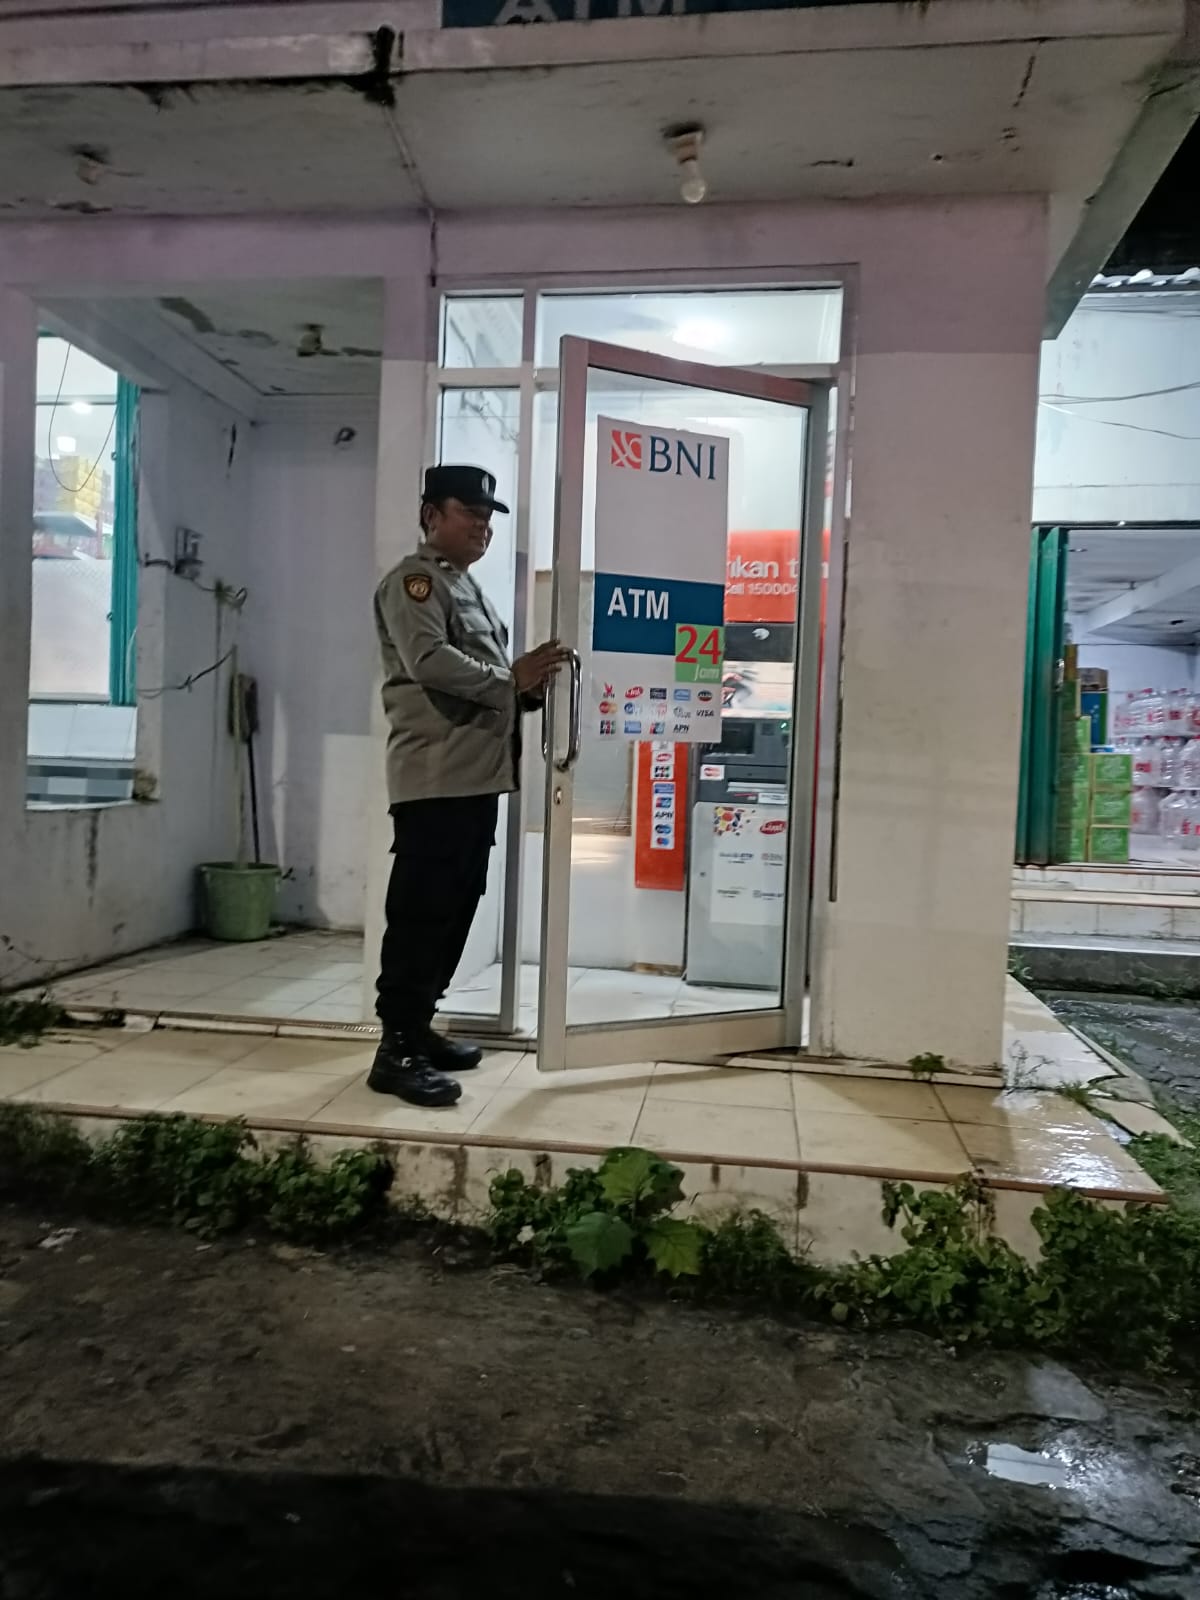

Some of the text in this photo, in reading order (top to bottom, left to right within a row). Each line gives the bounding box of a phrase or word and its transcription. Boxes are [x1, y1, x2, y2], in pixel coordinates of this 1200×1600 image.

[648, 434, 717, 481] BNI
[607, 586, 670, 620] ATM
[675, 625, 722, 665] 24
[696, 709, 715, 717] VISA
